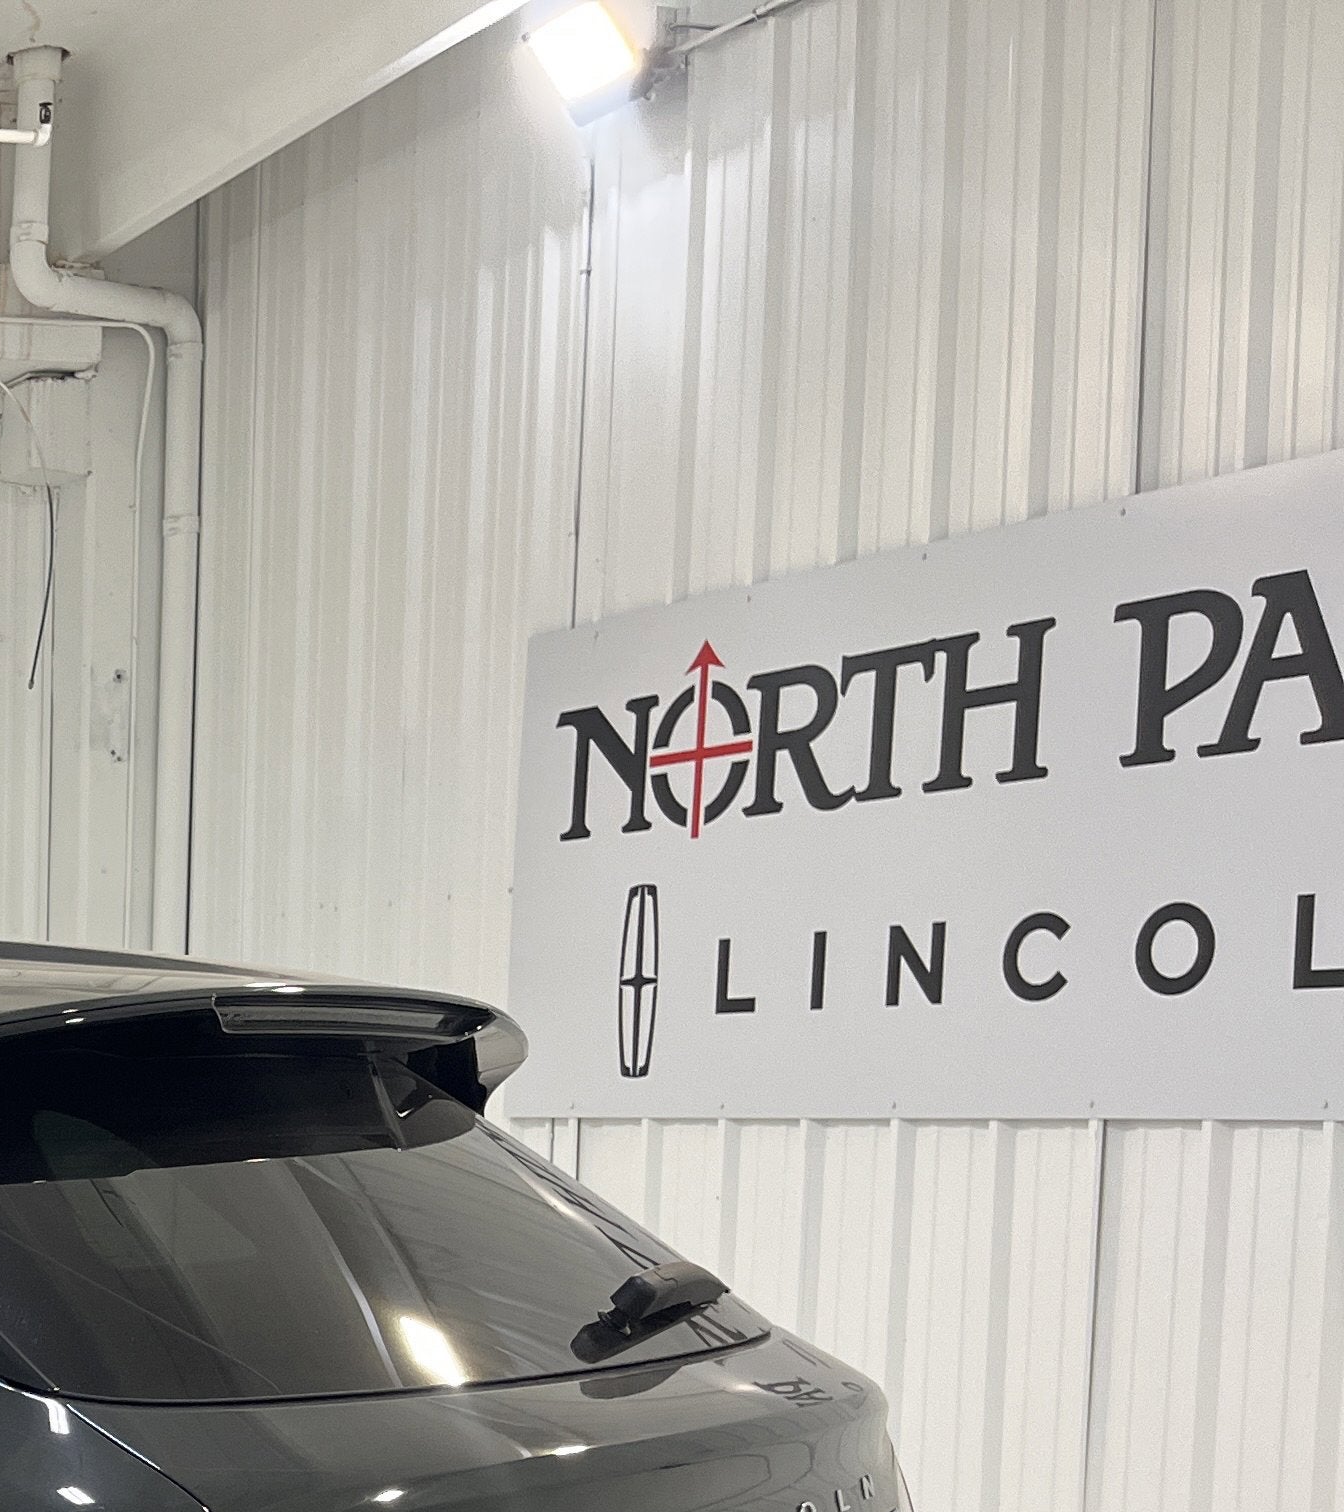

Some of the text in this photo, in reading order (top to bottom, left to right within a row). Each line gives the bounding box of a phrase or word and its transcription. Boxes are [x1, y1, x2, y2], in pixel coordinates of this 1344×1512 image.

[556, 569, 1344, 842] NORTH PA
[715, 893, 1344, 1015] LINCOL
